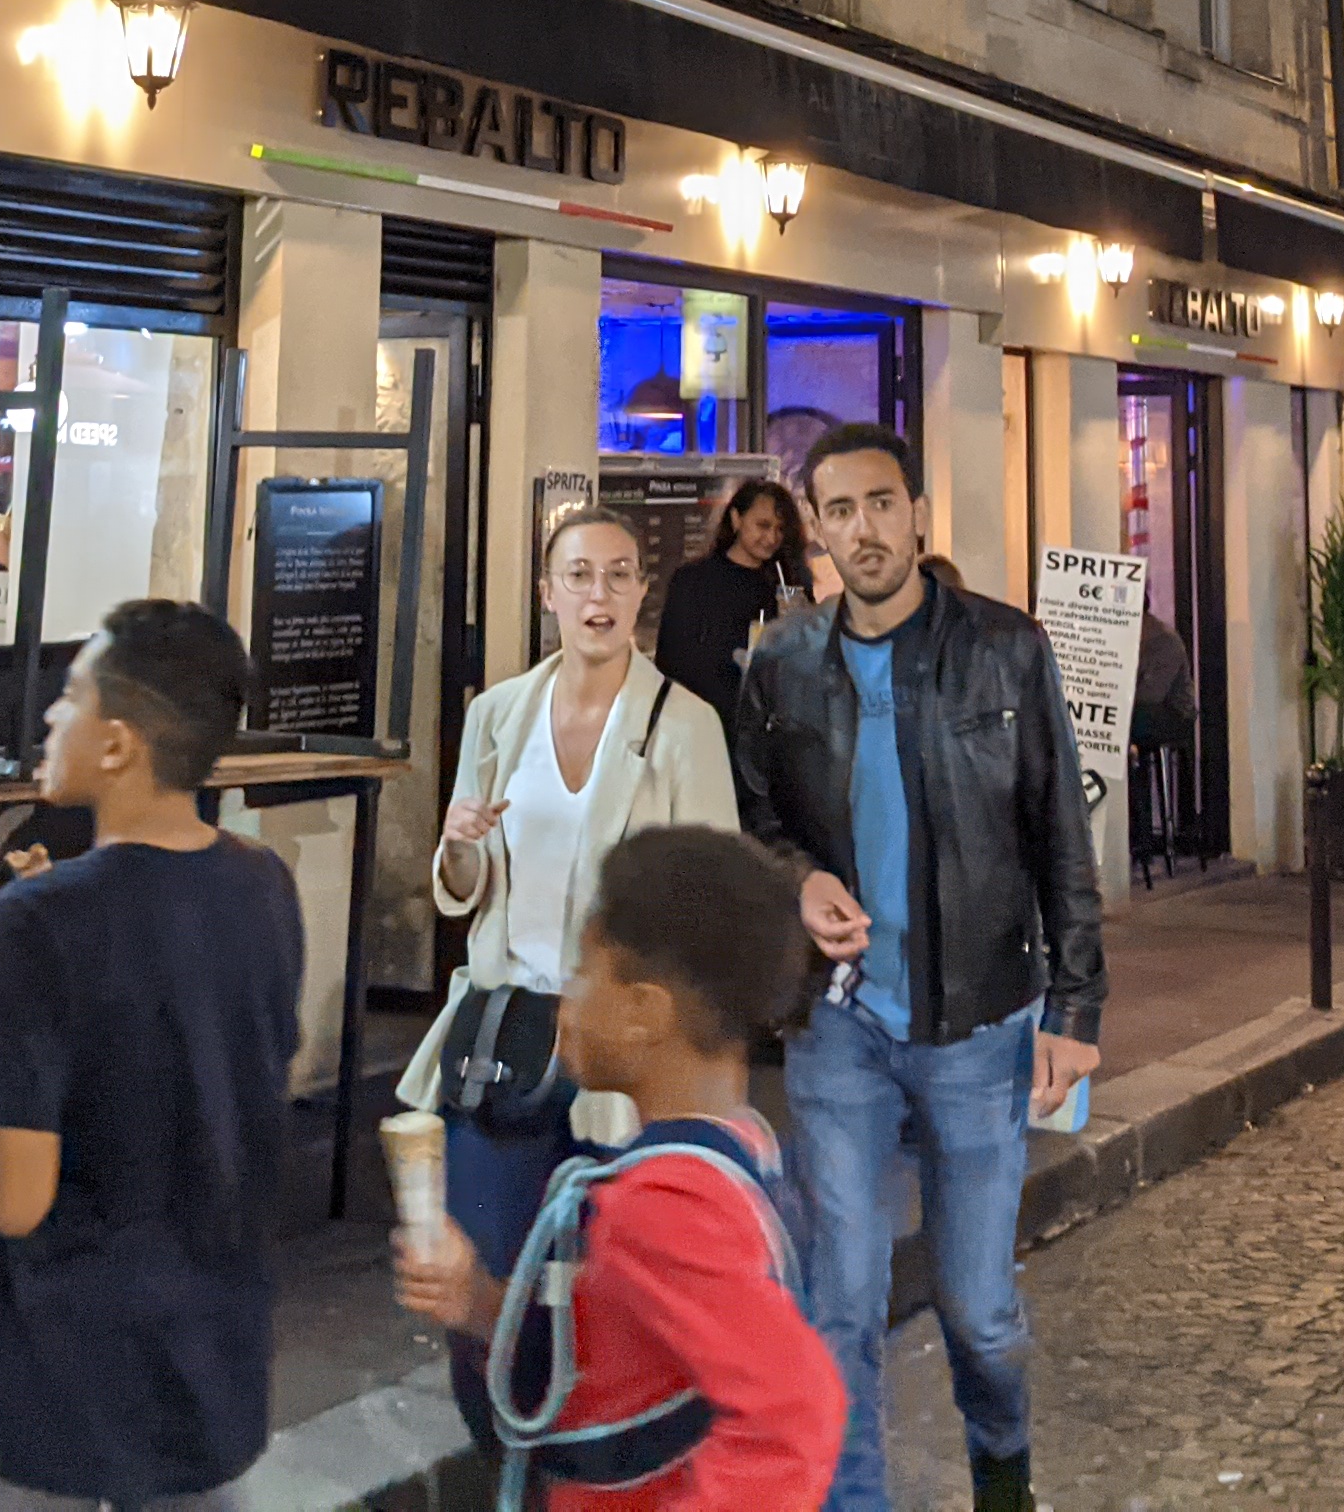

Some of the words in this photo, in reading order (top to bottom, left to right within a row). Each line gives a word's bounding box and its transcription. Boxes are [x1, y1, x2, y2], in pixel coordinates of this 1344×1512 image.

[322, 48, 626, 185] REBALTO
[1148, 281, 1262, 338] BALTO
[546, 471, 586, 491] SPRITZ
[1045, 550, 1143, 583] SPRITZ
[1078, 583, 1104, 601] 6€
[1066, 699, 1119, 726] NTE
